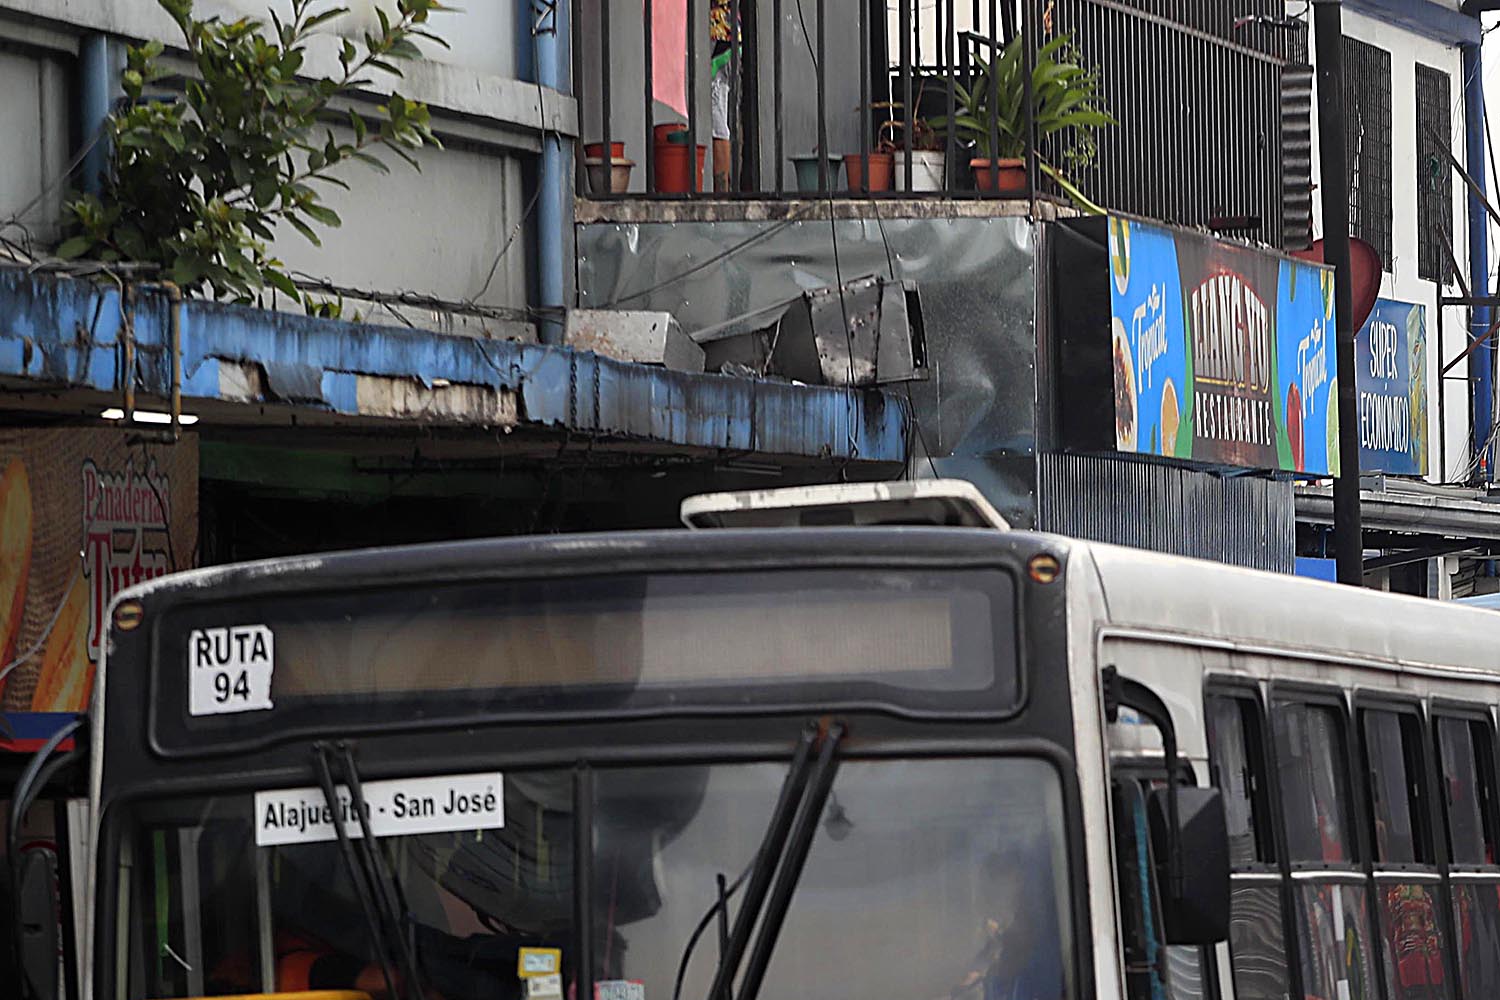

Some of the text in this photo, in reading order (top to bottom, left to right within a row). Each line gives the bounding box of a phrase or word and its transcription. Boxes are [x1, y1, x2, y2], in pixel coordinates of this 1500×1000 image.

[1132, 282, 1168, 395] Tropical
[1298, 318, 1327, 419] Tropical
[1369, 308, 1398, 380] SÚPER
[1195, 392, 1271, 447] RESTAURANTE
[1360, 382, 1409, 454] ECONÓMICO
[197, 631, 268, 667] RUTA
[214, 670, 250, 703] 94
[393, 792, 435, 819] San
[443, 785, 496, 815] José
